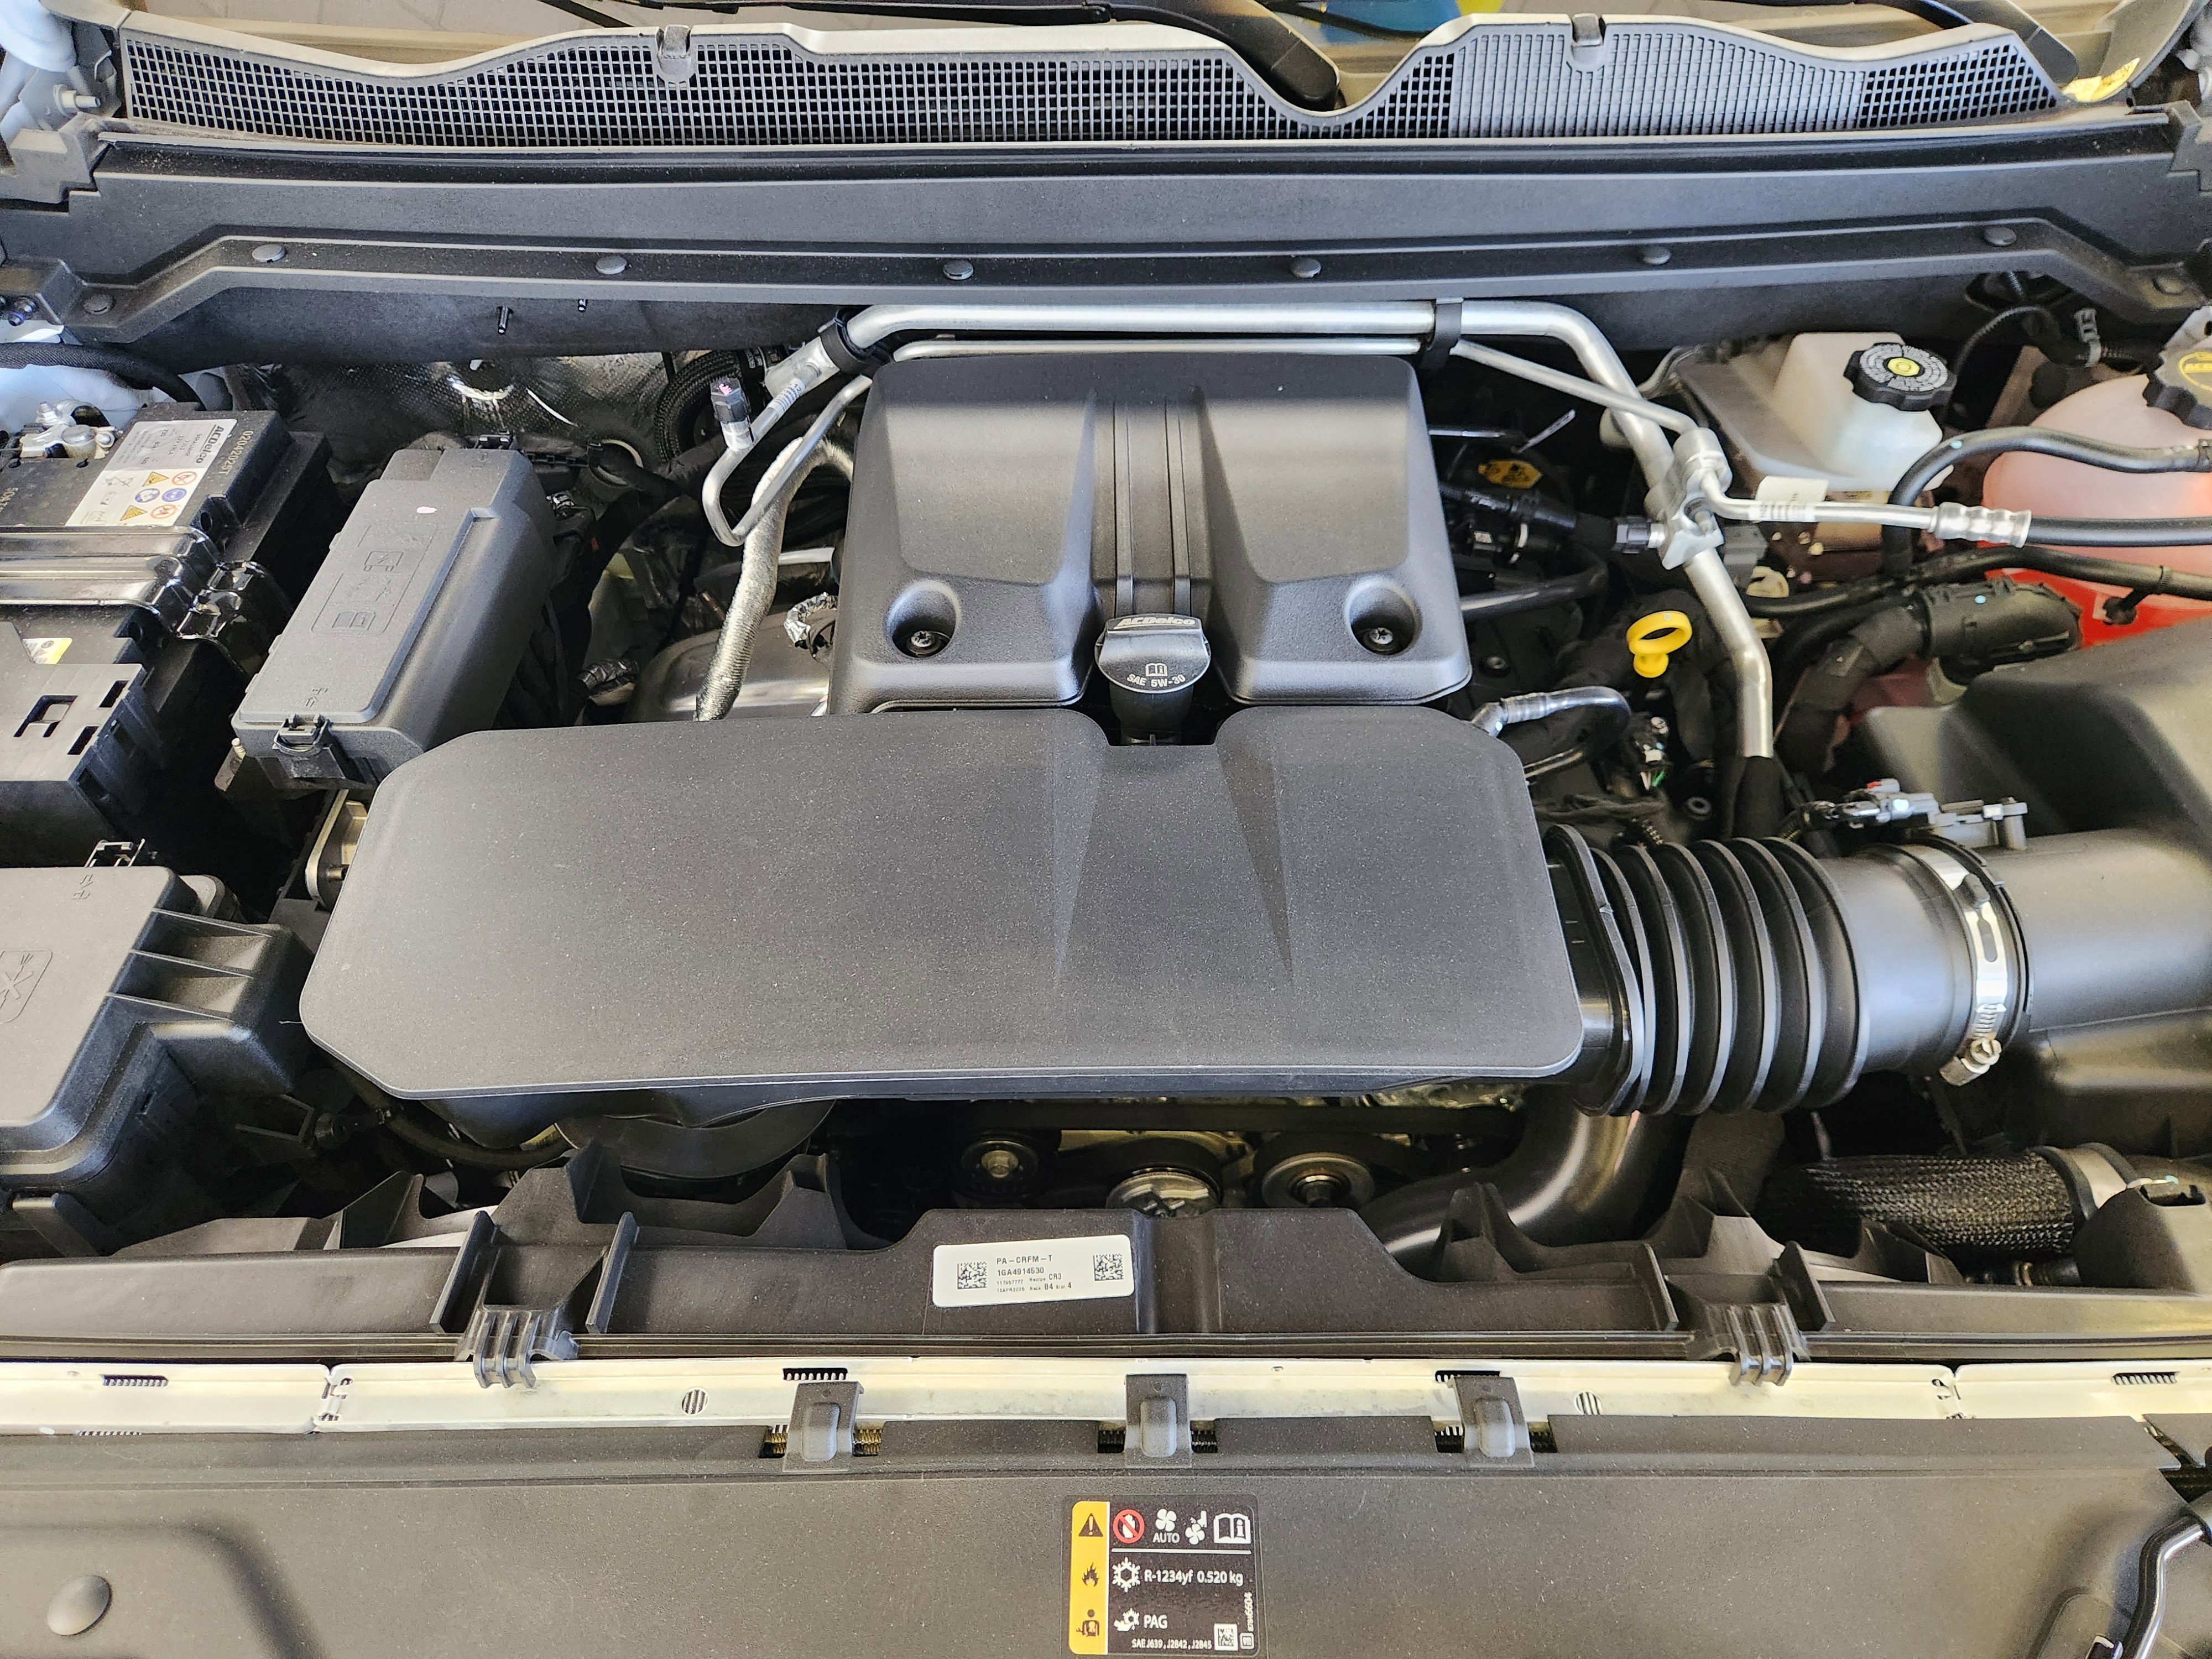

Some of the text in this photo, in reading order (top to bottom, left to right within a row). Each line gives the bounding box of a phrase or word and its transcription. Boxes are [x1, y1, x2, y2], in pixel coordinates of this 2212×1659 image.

[195, 425, 227, 464] ACDelco
[218, 430, 255, 476] 02042025T
[1115, 617, 1196, 627] ACDelco
[1126, 674, 1186, 687] SAE 5W-30
[1152, 1532, 1180, 1544] AUTO
[1144, 1568, 1244, 1587] R-1234yf 0.520 kg
[1144, 1614, 1168, 1629] PAG
[1131, 1638, 1146, 1648] SAE
